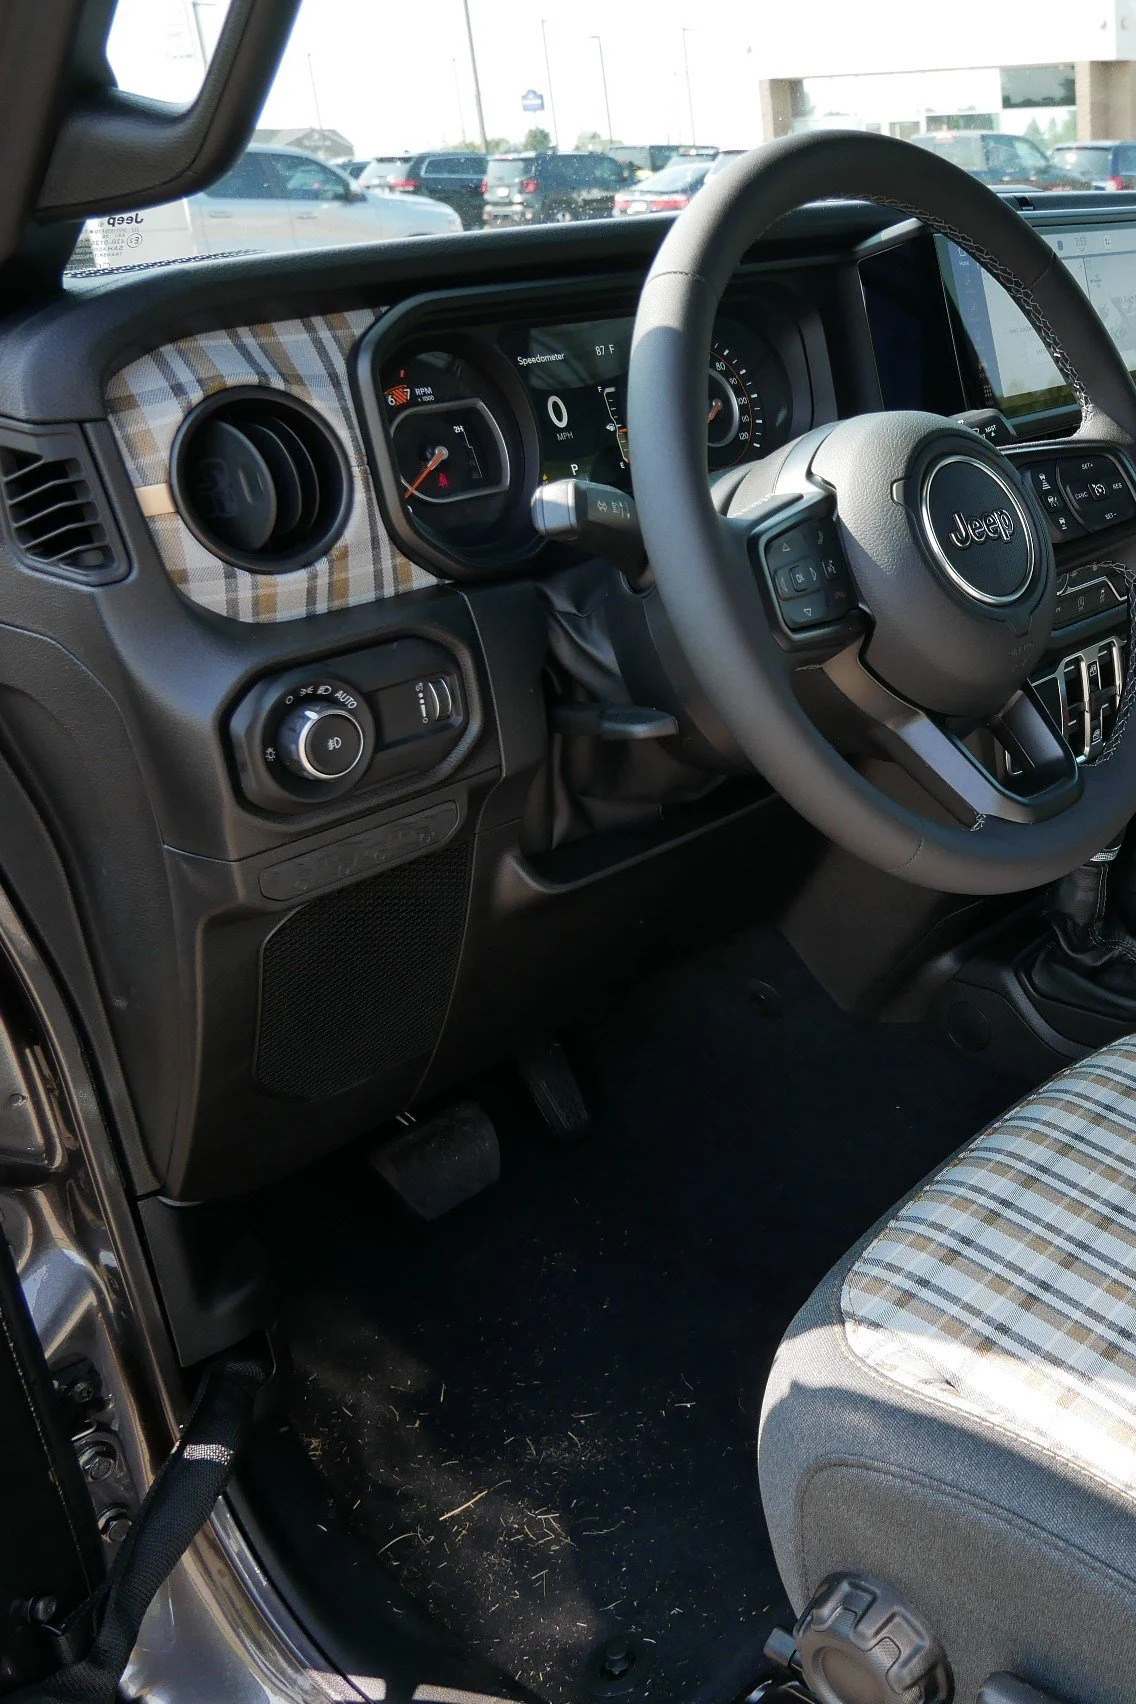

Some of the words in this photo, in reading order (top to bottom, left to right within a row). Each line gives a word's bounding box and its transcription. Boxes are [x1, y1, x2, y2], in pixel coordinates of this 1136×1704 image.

[595, 345, 605, 356] 87
[608, 344, 615, 354] F
[517, 352, 565, 367] Speedometer
[715, 362, 726, 371] 80
[729, 377, 738, 385] 90
[387, 395, 396, 406] 6
[403, 388, 411, 400] 7
[414, 386, 433, 396] RPM
[547, 395, 568, 428] 0
[556, 431, 574, 442] MPH
[571, 463, 579, 476] P
[948, 508, 1014, 549] Jeep
[334, 690, 358, 709] AUTO
